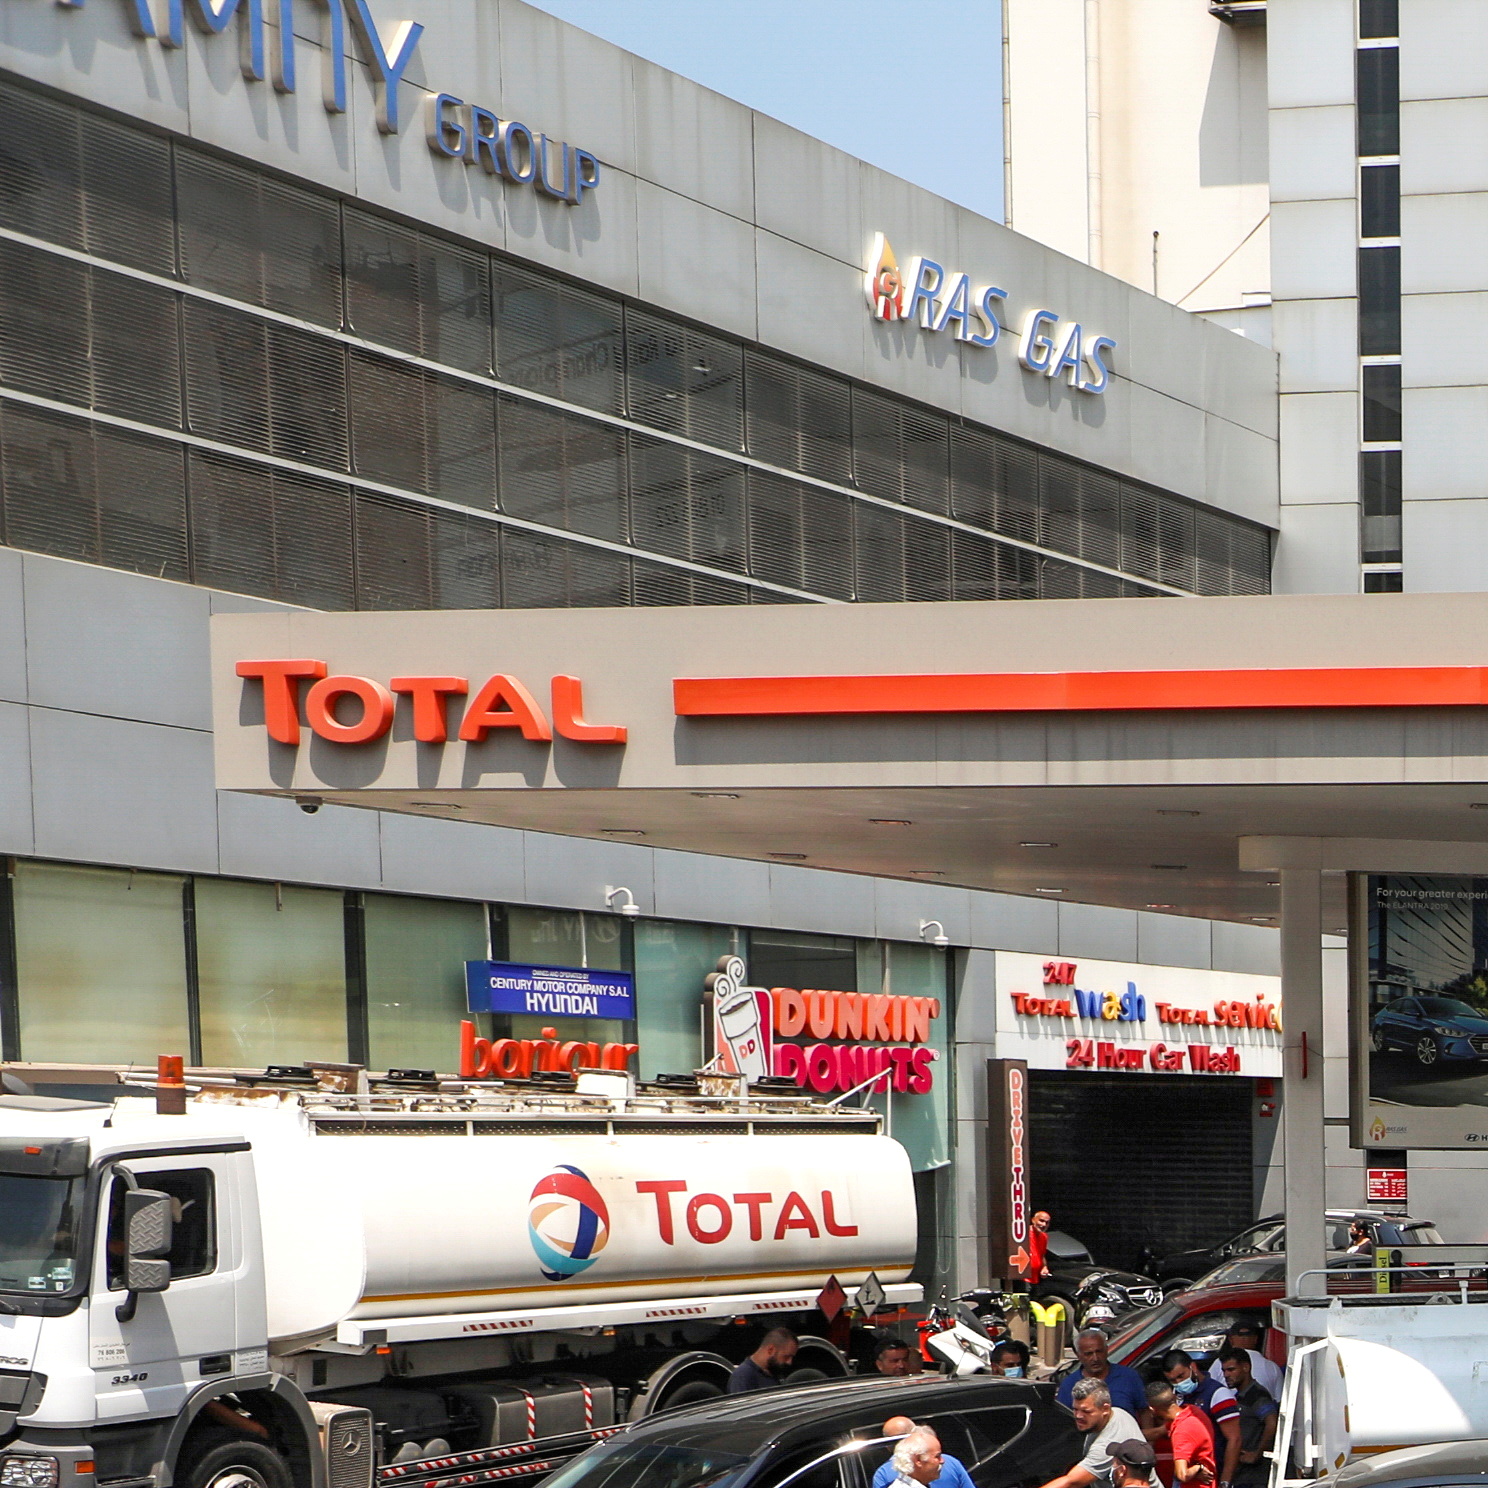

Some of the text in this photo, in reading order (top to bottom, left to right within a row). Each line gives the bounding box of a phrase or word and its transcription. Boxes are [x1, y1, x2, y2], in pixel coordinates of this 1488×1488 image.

[428, 92, 601, 205] GROUP
[901, 256, 1116, 394] RAS GAS
[236, 659, 628, 746] TOTAL
[1376, 887, 1393, 897] For
[1394, 889, 1417, 899] your
[1418, 889, 1455, 899] greater
[490, 977, 533, 991] CENTURY
[534, 980, 566, 993] MOTOR
[566, 983, 608, 996] COMPANY
[525, 992, 599, 1015] HYUNDAI
[1010, 992, 1077, 1018] TOTAL
[1075, 981, 1146, 1022] wash
[1155, 1002, 1215, 1026] TOTAL
[460, 1020, 639, 1079] bonjour
[773, 1042, 934, 1096] DONUTS
[1065, 1039, 1241, 1073] 24 Hour Car Wash
[636, 1179, 858, 1246] TOTAL
[110, 1372, 149, 1386] 3340
